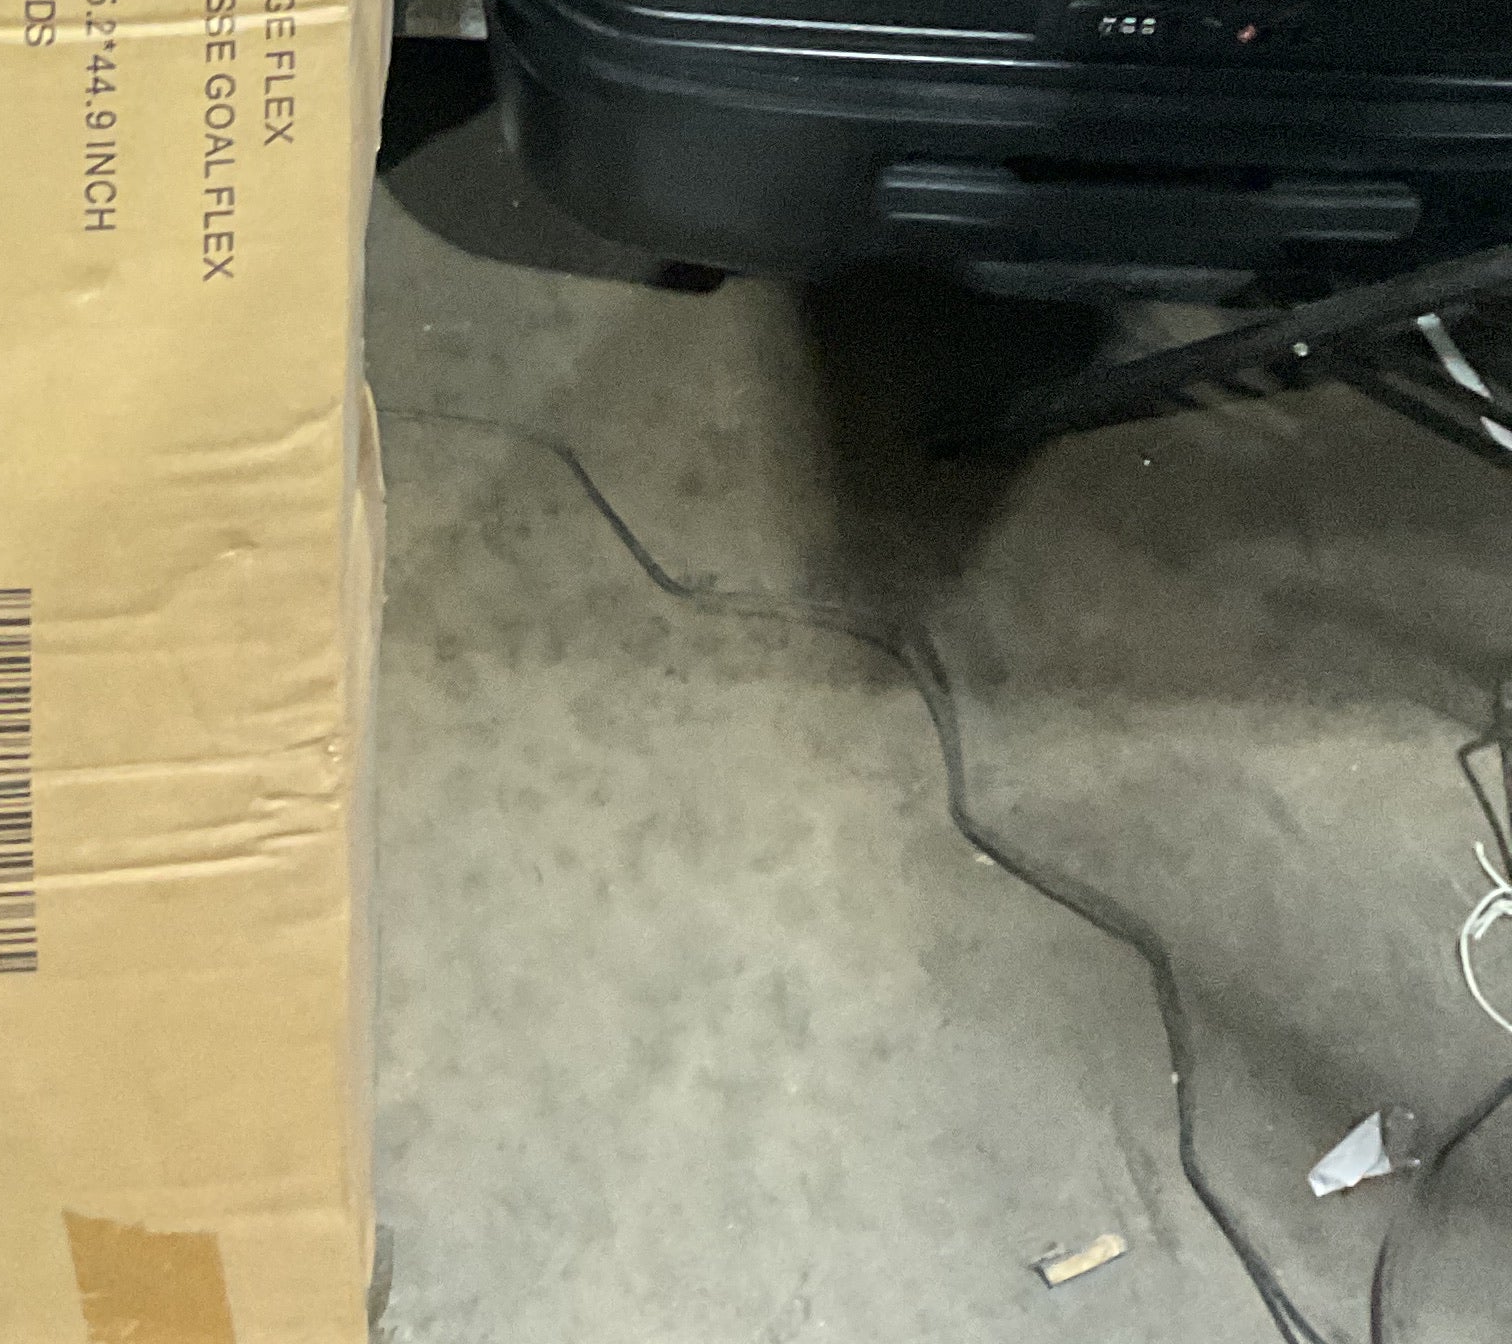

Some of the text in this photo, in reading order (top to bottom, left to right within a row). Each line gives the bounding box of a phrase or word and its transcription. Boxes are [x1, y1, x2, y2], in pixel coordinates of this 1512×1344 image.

[203, 74, 235, 178] GOAL
[263, 52, 295, 146] FLEX
[85, 141, 116, 232] INCH
[203, 187, 234, 282] FLEX
